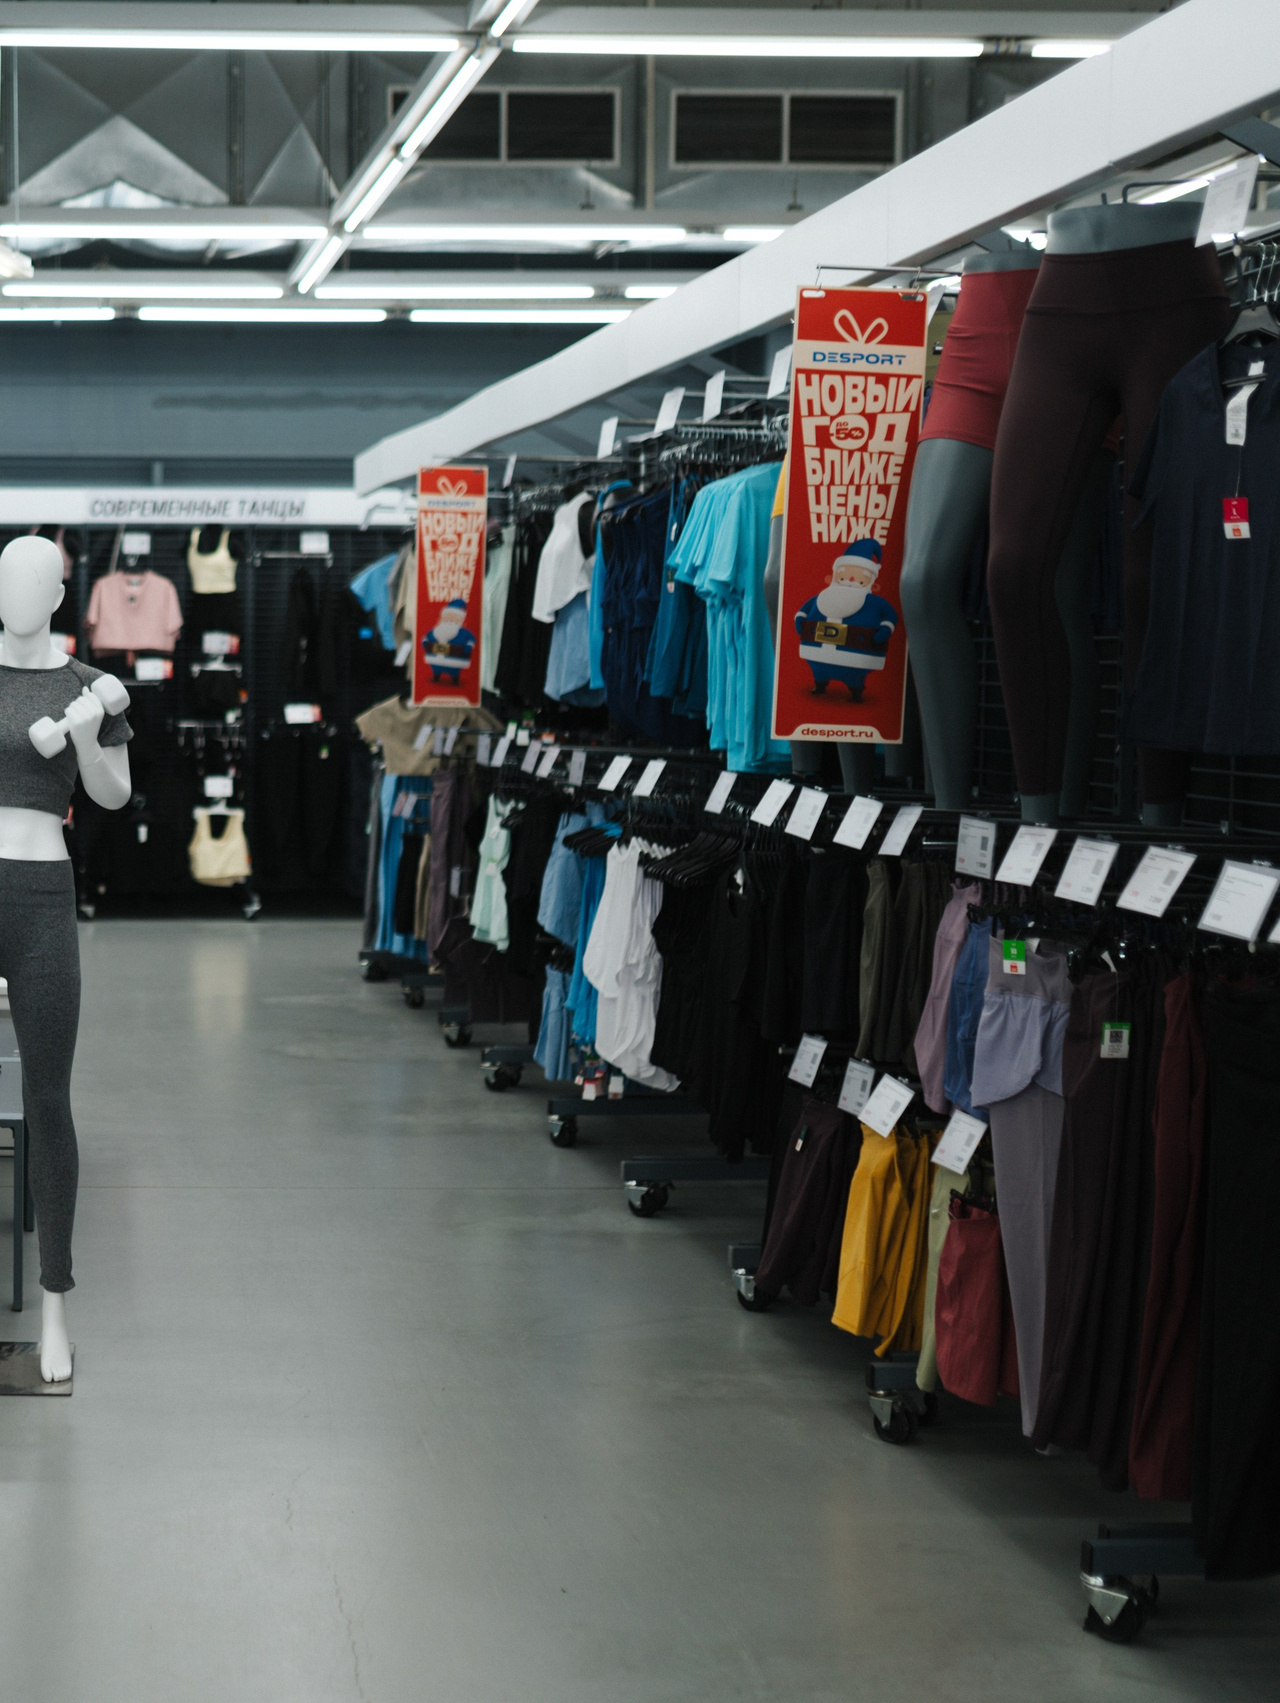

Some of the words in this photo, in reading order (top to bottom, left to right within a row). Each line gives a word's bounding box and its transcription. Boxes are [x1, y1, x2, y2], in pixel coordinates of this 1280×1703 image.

[812, 351, 907, 366] DESPORT
[803, 446, 905, 486] БЛИЖЕ
[89, 499, 229, 518] СОВРЕМЕННЫЕ
[238, 499, 307, 521] ТАНЦЫ
[807, 484, 899, 520] ЦЕНЫ
[810, 512, 892, 546] НИЖЕ
[801, 727, 874, 738] desport.ru
